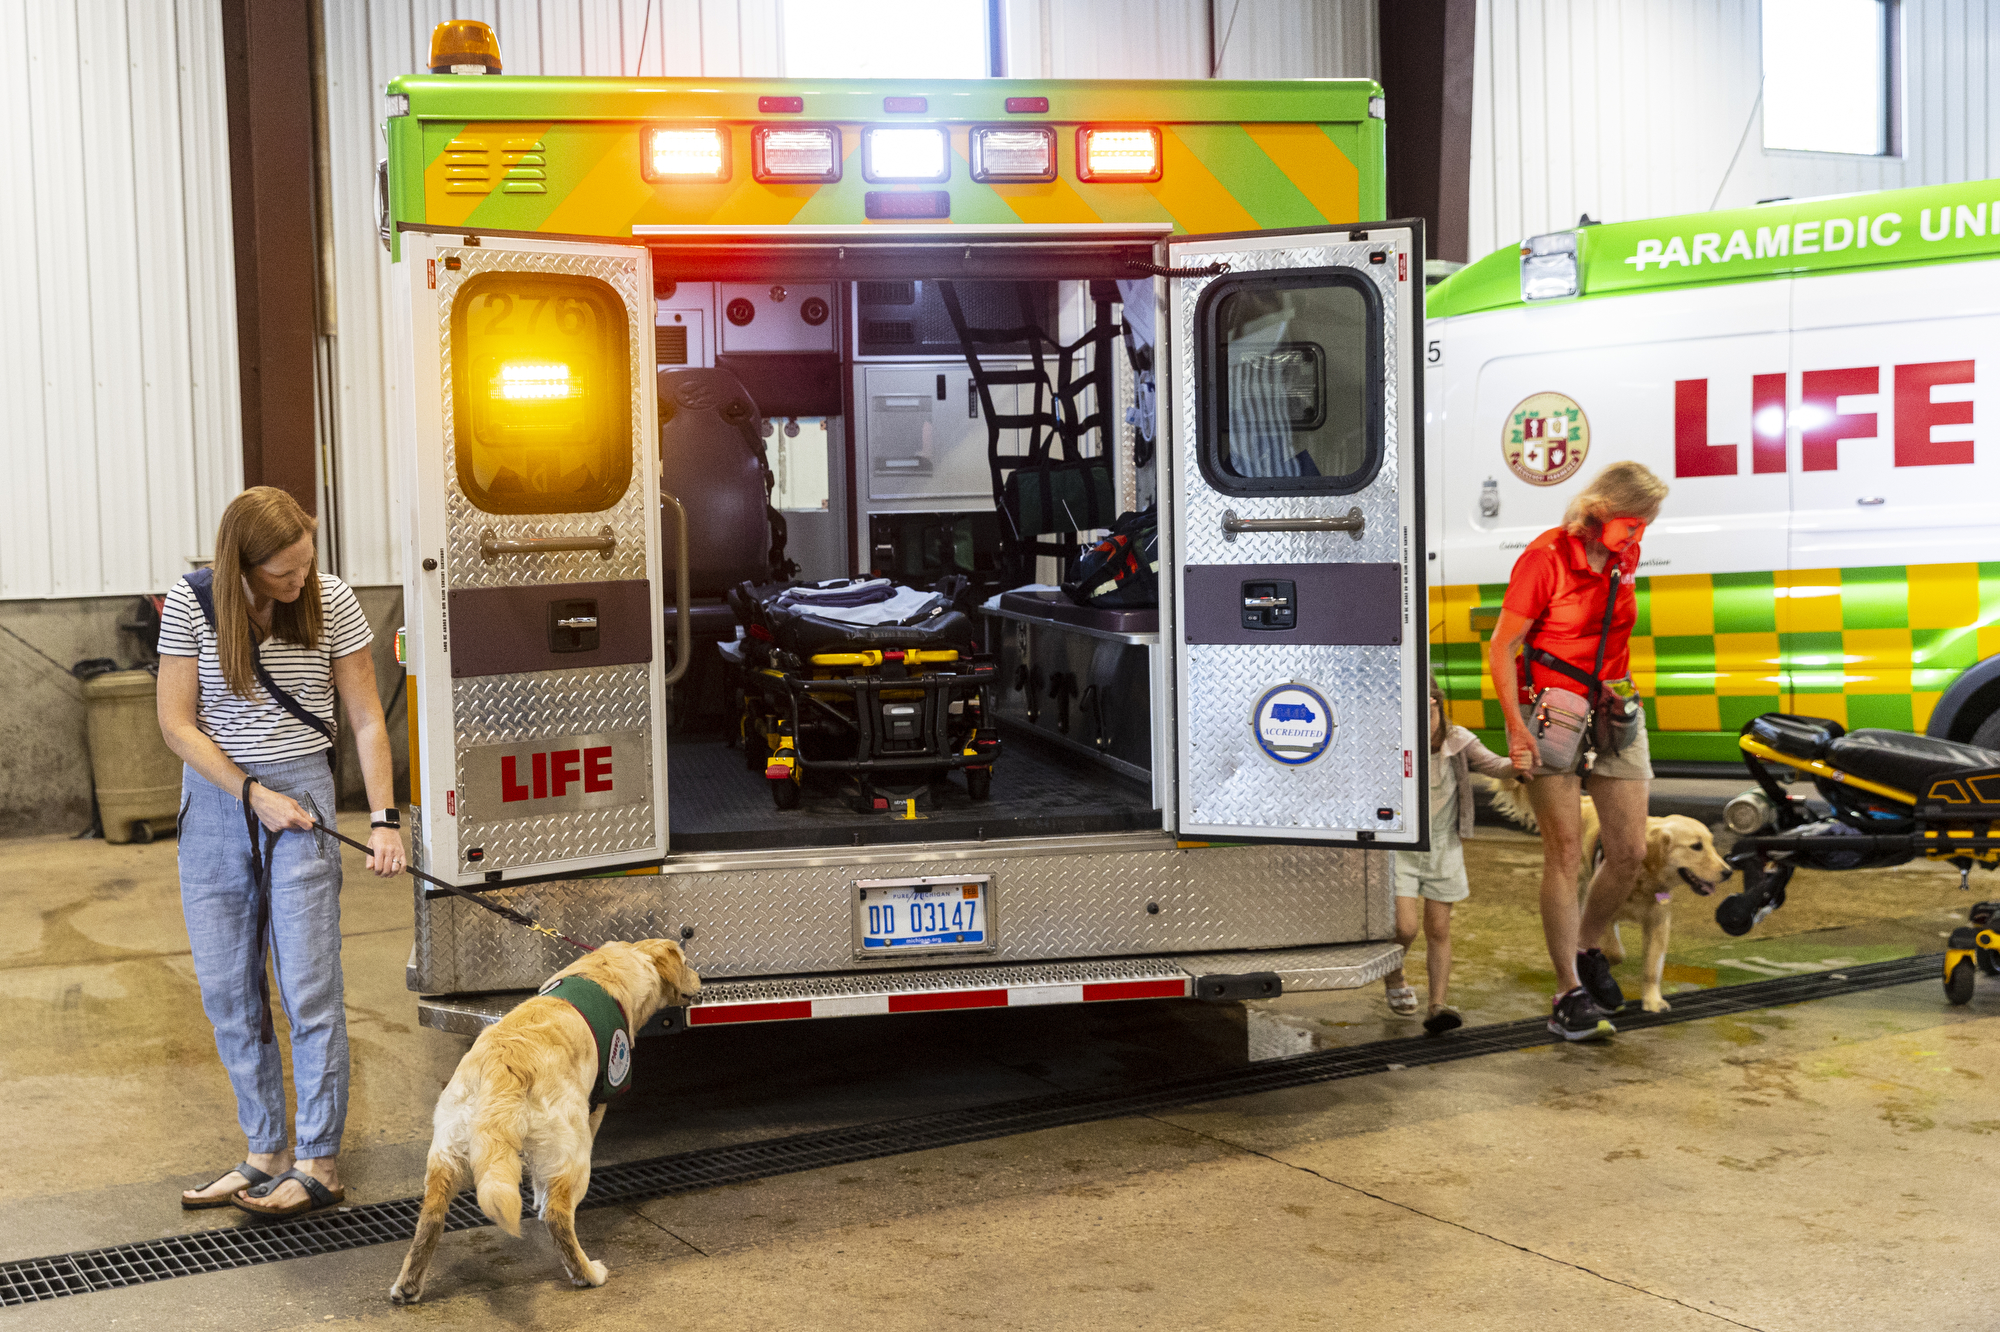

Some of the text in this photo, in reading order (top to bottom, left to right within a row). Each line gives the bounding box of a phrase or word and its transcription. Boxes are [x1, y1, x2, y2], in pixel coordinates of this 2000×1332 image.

[1625, 211, 1902, 271] PARAMEDIC
[484, 293, 587, 335] 276
[1428, 340, 1441, 363] 5
[1675, 359, 1975, 478] LIFE
[1264, 728, 1323, 738] ACCREDITED
[501, 745, 613, 803] LIFE
[963, 886, 977, 896] FEB
[868, 900, 976, 935] DD 03147
[905, 936, 942, 945] michigan.org
